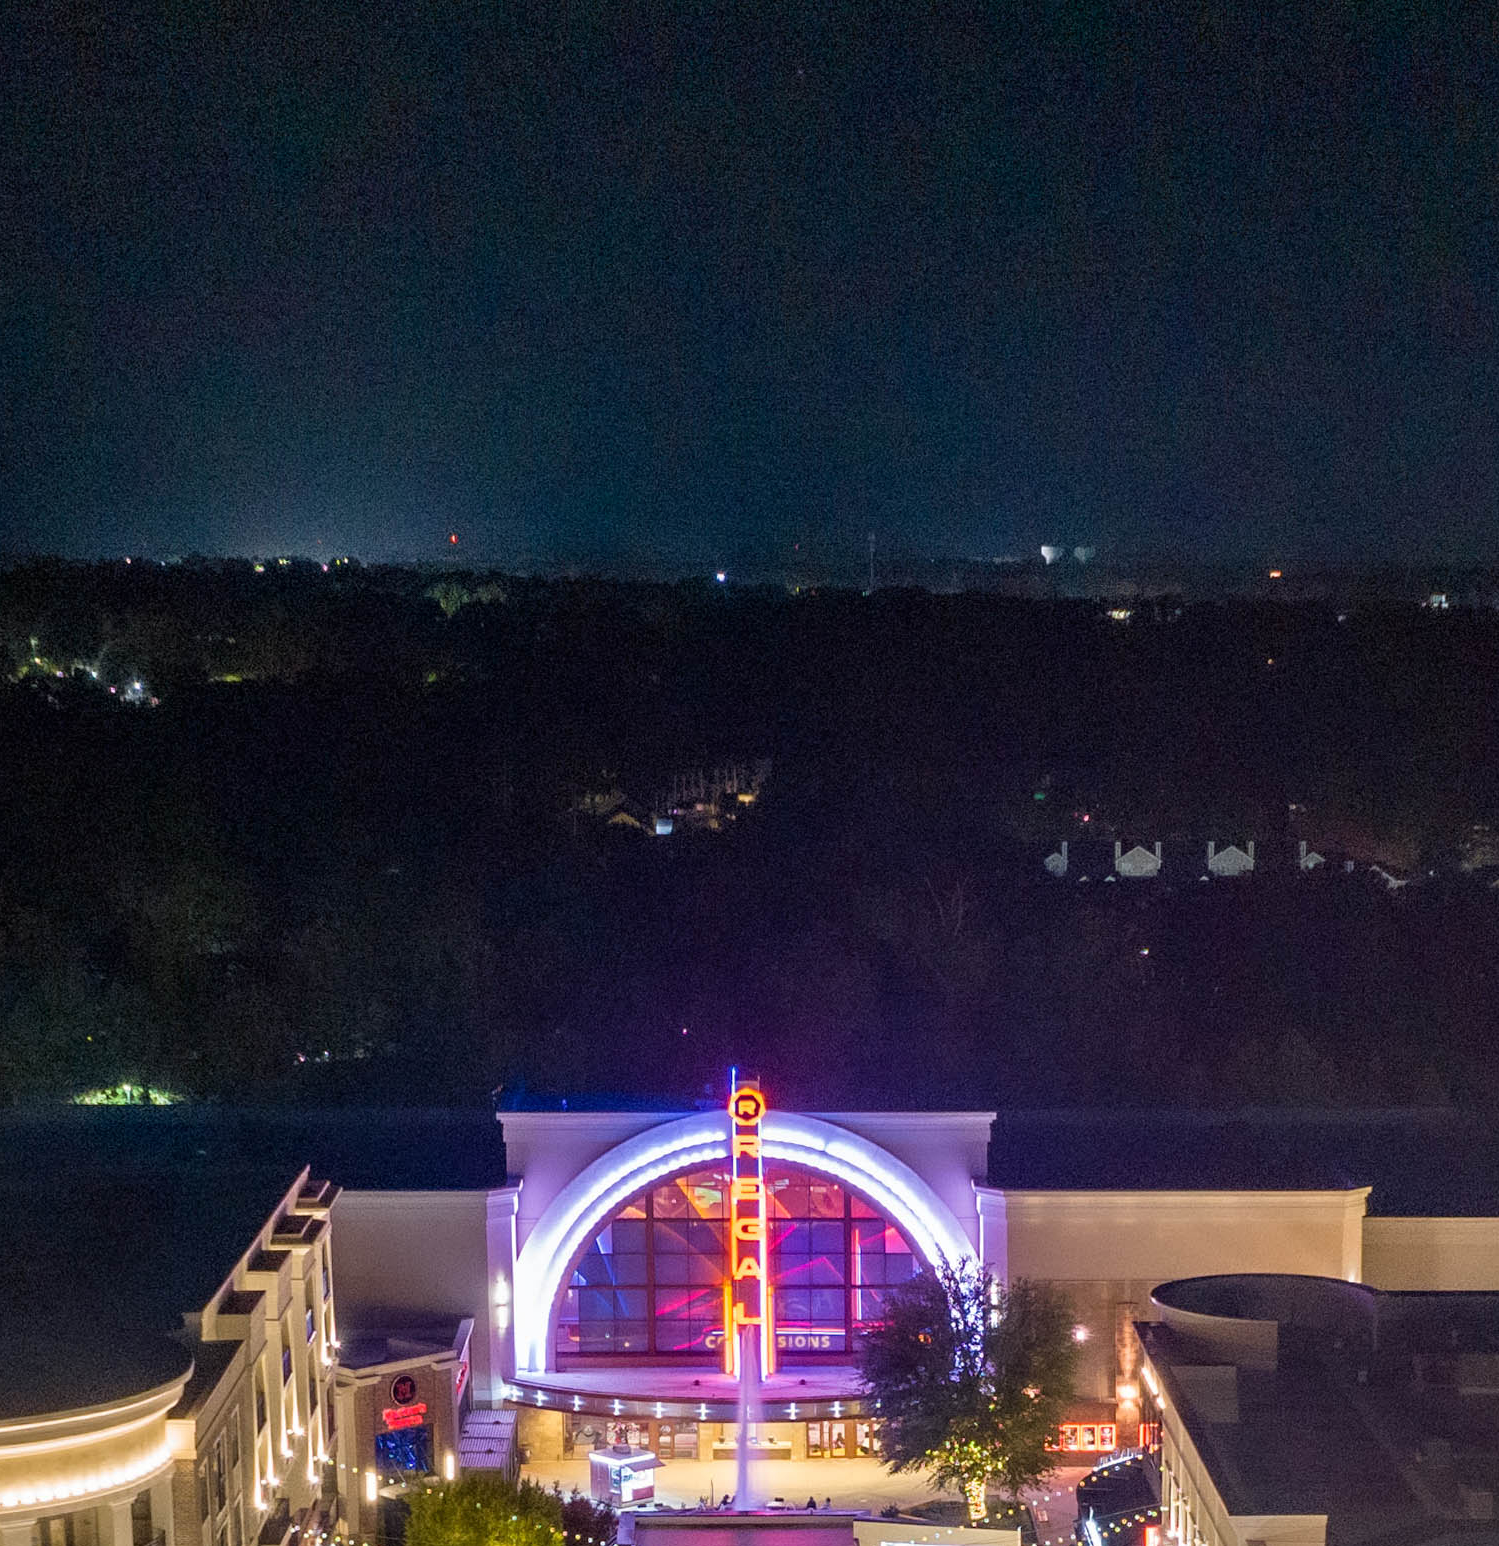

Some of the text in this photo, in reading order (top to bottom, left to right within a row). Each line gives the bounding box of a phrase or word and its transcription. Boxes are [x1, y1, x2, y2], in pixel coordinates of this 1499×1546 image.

[738, 1100, 757, 1116] R
[732, 1134, 763, 1325] REGAL
[704, 1335, 830, 1349] CSIONS
